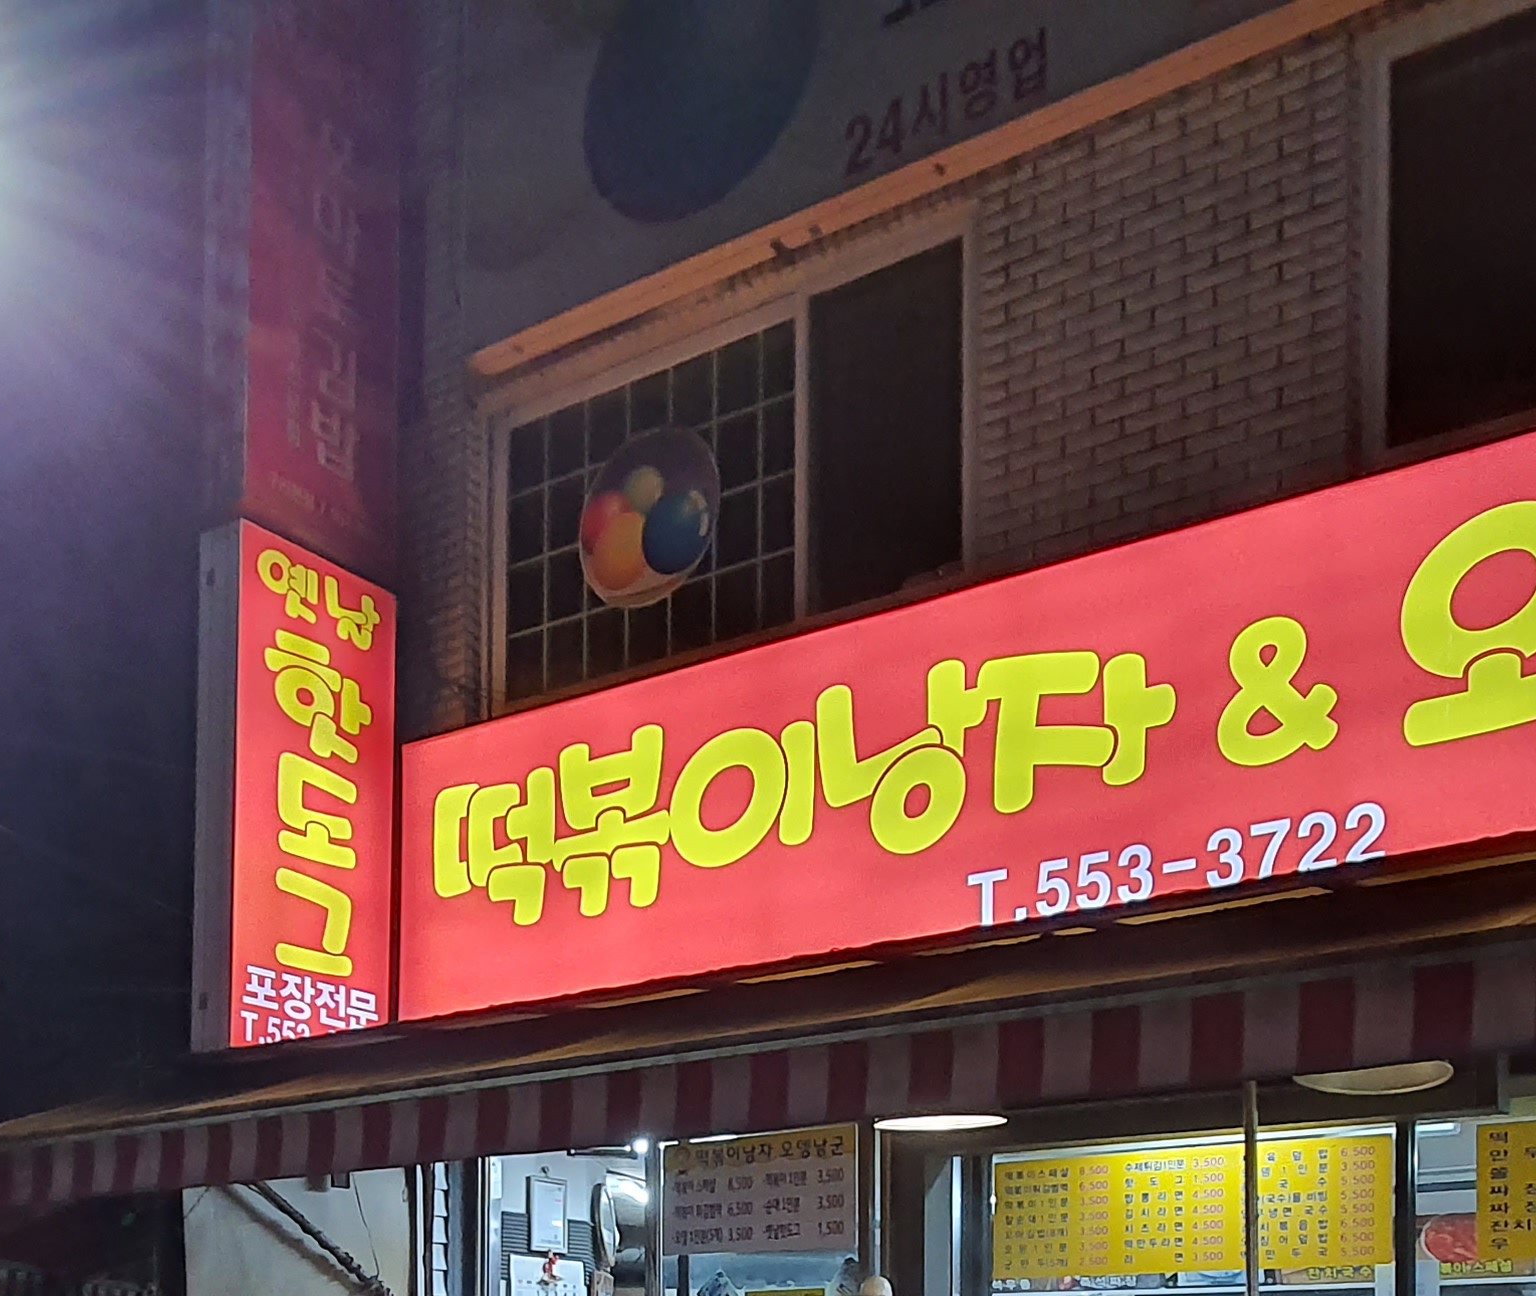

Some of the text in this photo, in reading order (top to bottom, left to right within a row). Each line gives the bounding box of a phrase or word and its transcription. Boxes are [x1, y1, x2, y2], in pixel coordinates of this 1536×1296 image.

[256, 548, 382, 652] 옛날
[262, 627, 374, 978] 핫도그
[431, 648, 1177, 927] 떡볶이낭자
[1216, 615, 1339, 767] &
[966, 801, 1388, 929] T.553-3722
[241, 964, 380, 1030] 포장전문
